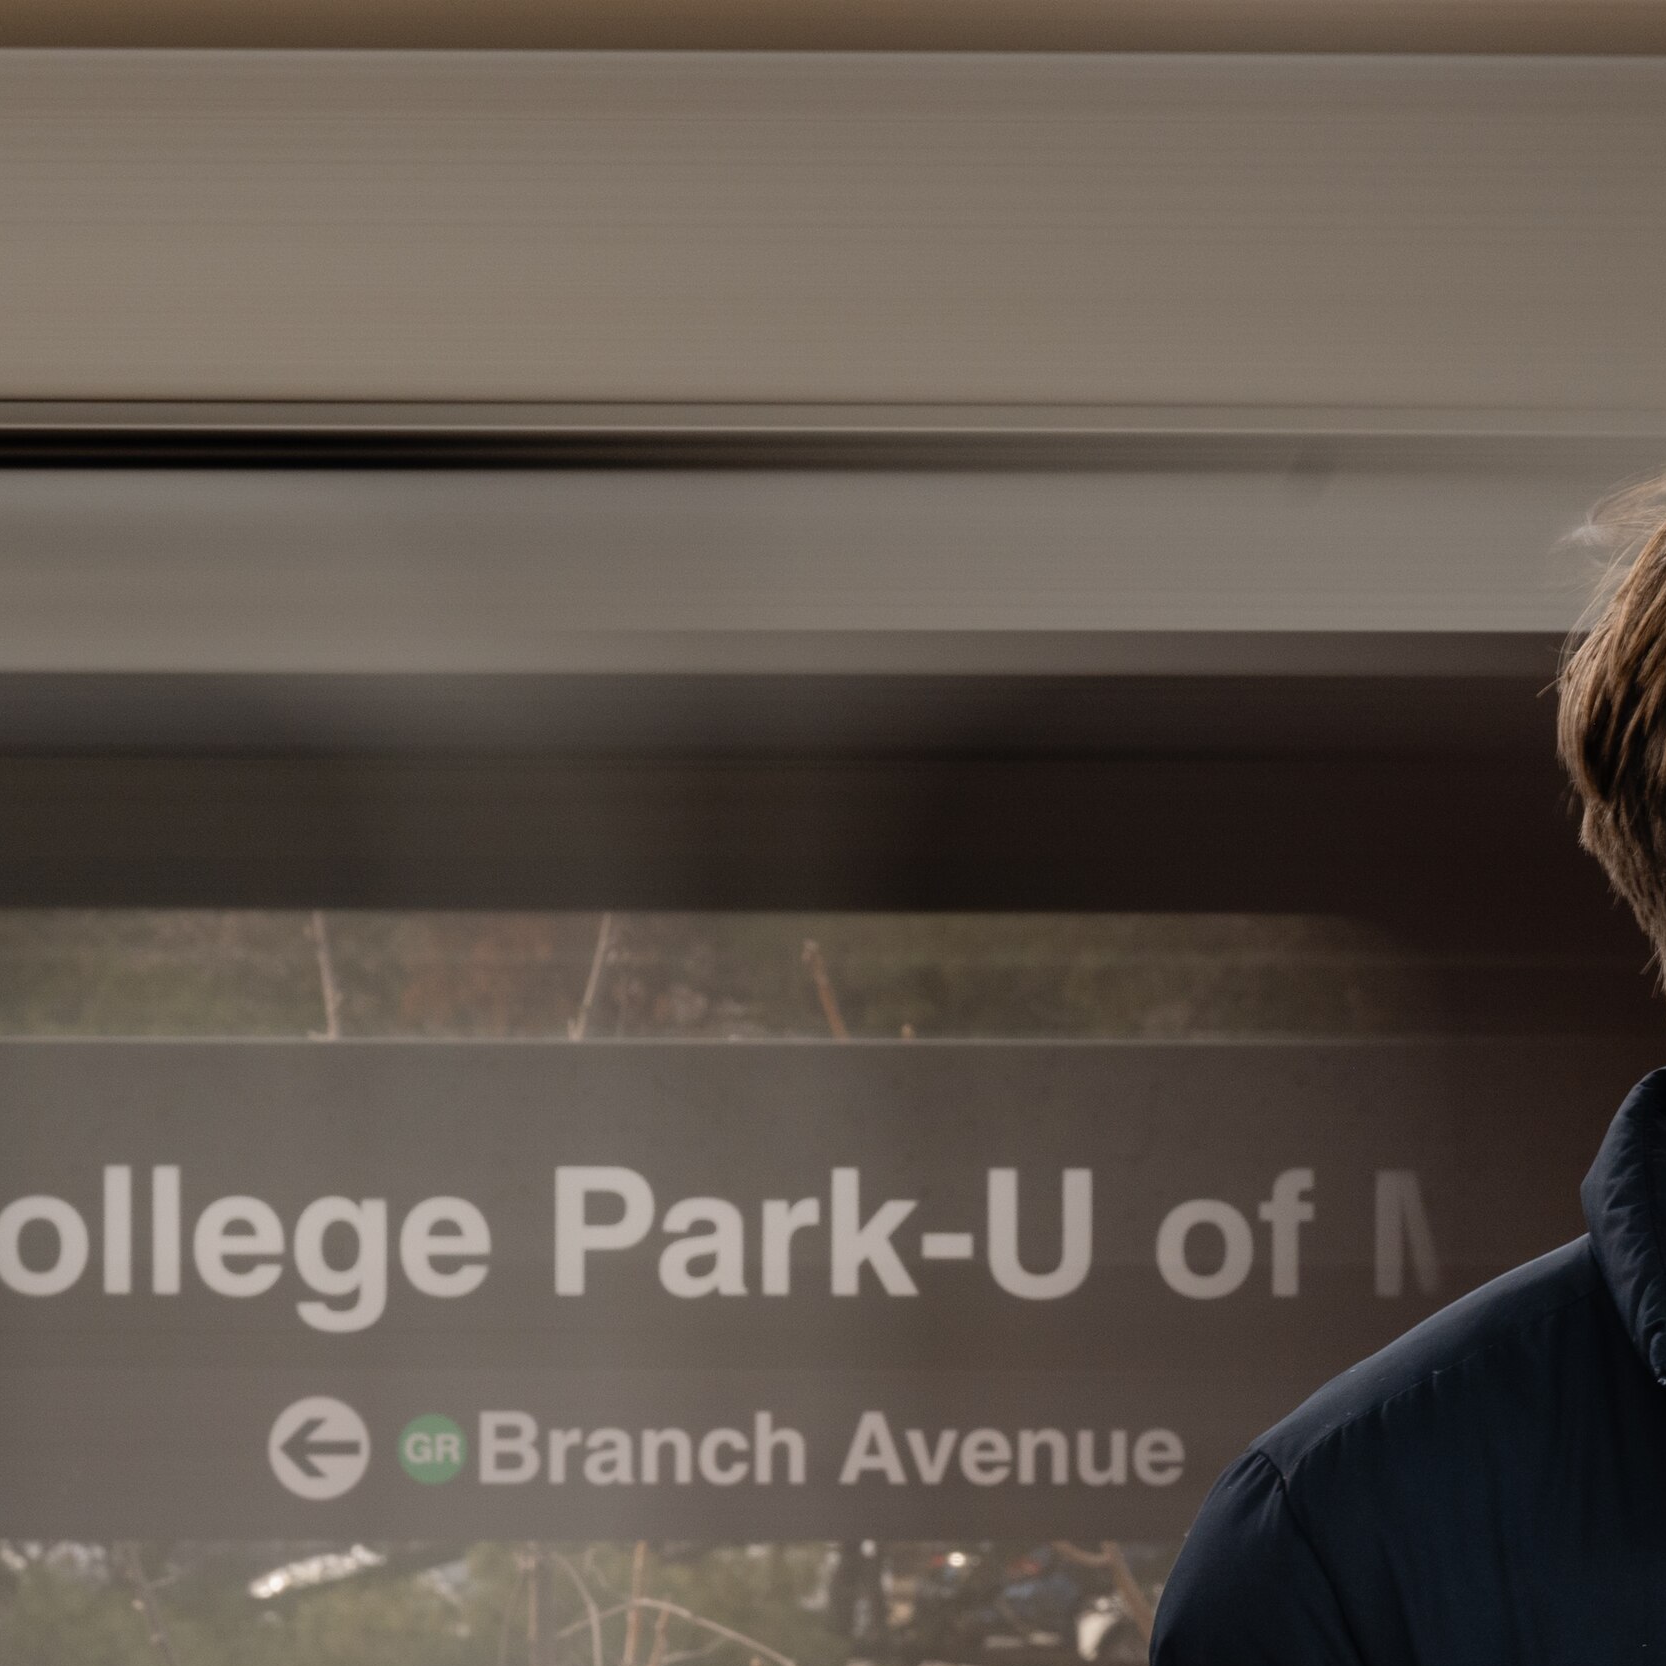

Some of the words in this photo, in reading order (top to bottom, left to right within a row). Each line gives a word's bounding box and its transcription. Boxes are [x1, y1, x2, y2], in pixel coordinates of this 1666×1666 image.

[552, 1163, 1095, 1300] Park-U
[1155, 1168, 1316, 1300] of
[404, 1432, 461, 1464] GR
[478, 1409, 806, 1486] Branch
[838, 1409, 1185, 1486] Avenue
